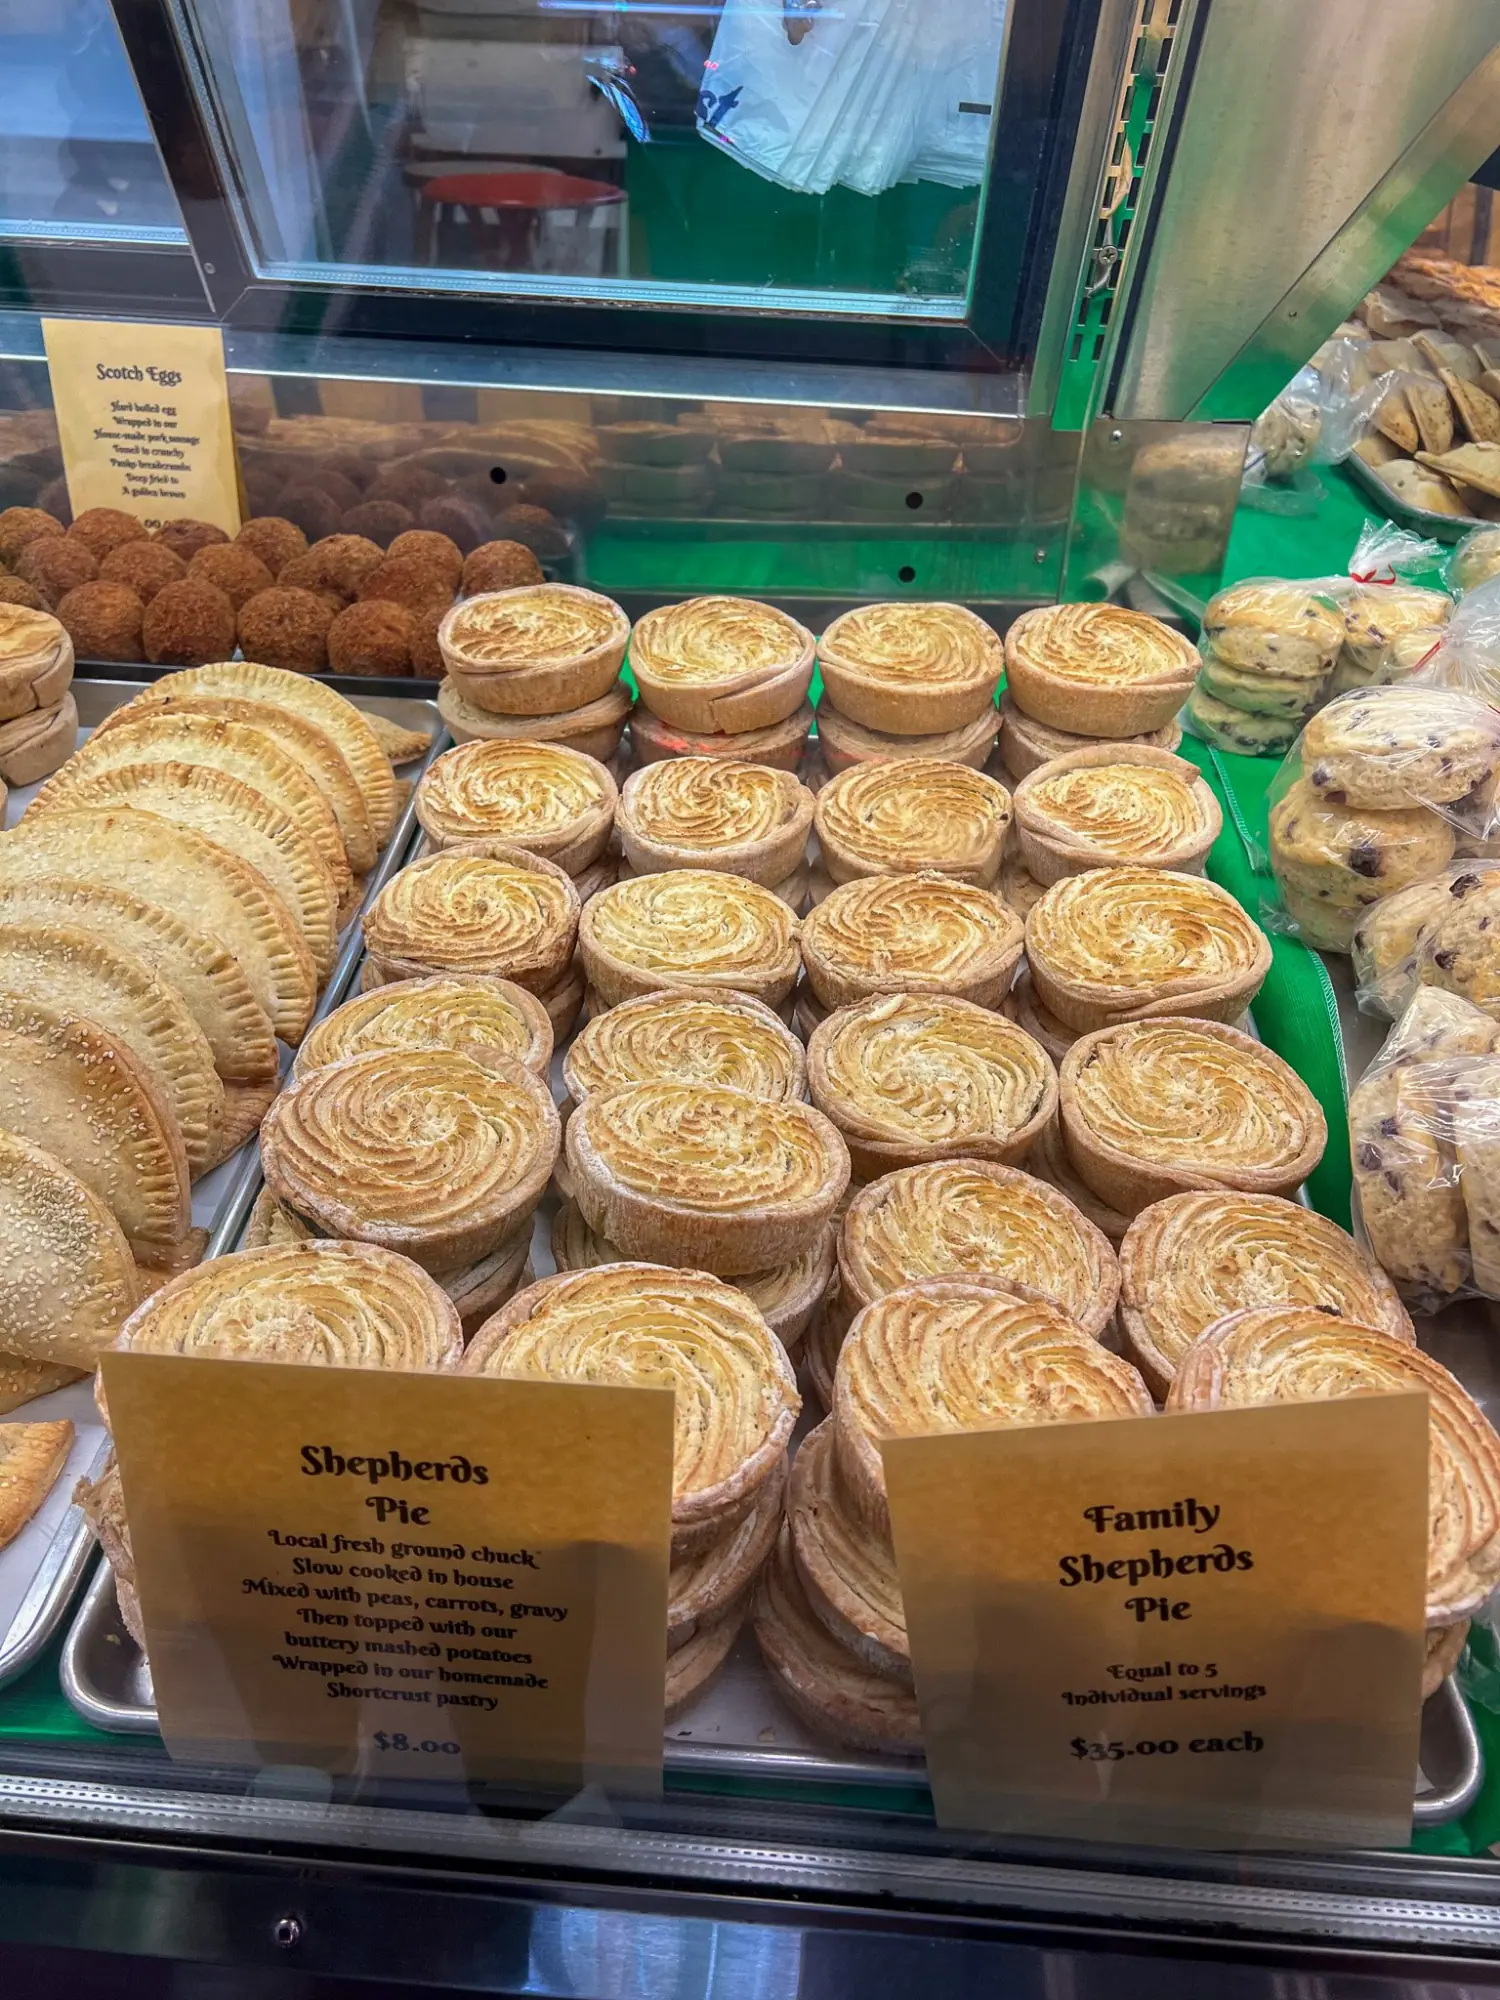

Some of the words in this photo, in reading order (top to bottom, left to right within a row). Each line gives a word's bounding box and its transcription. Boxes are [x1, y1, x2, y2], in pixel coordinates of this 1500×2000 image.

[96, 363, 144, 381] Scotch
[145, 366, 182, 387] Eggs
[300, 1445, 489, 1485] Shepherds
[365, 1496, 432, 1526] Pie
[1083, 1498, 1221, 1534] Family
[267, 1529, 328, 1550] Local
[329, 1534, 385, 1555] fresh
[391, 1541, 466, 1560] ground
[471, 1545, 541, 1570] chuck
[1058, 1544, 1254, 1587] Shepherds
[292, 1557, 344, 1577] Slow
[348, 1563, 423, 1583] cooked
[427, 1569, 448, 1586] in
[453, 1571, 515, 1590] house
[242, 1577, 310, 1599] Mixed
[313, 1585, 362, 1604] with
[367, 1592, 420, 1610] peas,
[424, 1595, 506, 1615] carrots,
[509, 1601, 569, 1622] gravy
[1124, 1596, 1193, 1622] Pie
[296, 1608, 349, 1627] Then
[353, 1614, 425, 1634] topped
[428, 1621, 477, 1637] with
[480, 1627, 518, 1640] our
[284, 1631, 360, 1654] buttery
[364, 1641, 441, 1657] mashed
[445, 1647, 534, 1665] potatoes
[271, 1654, 368, 1676] Wrapped
[373, 1662, 394, 1677] in
[398, 1667, 434, 1680] our
[438, 1670, 550, 1690] homemade
[1106, 1660, 1172, 1683] Equal
[1176, 1662, 1200, 1677] to
[1204, 1663, 1219, 1678] 5
[326, 1682, 433, 1704] Shortcrust
[436, 1692, 499, 1711] pastry
[1061, 1686, 1173, 1706] Individual
[1178, 1683, 1267, 1702] servings
[372, 1729, 462, 1755] $8.00
[1069, 1736, 1180, 1761] $35.00
[1188, 1730, 1265, 1754] each
